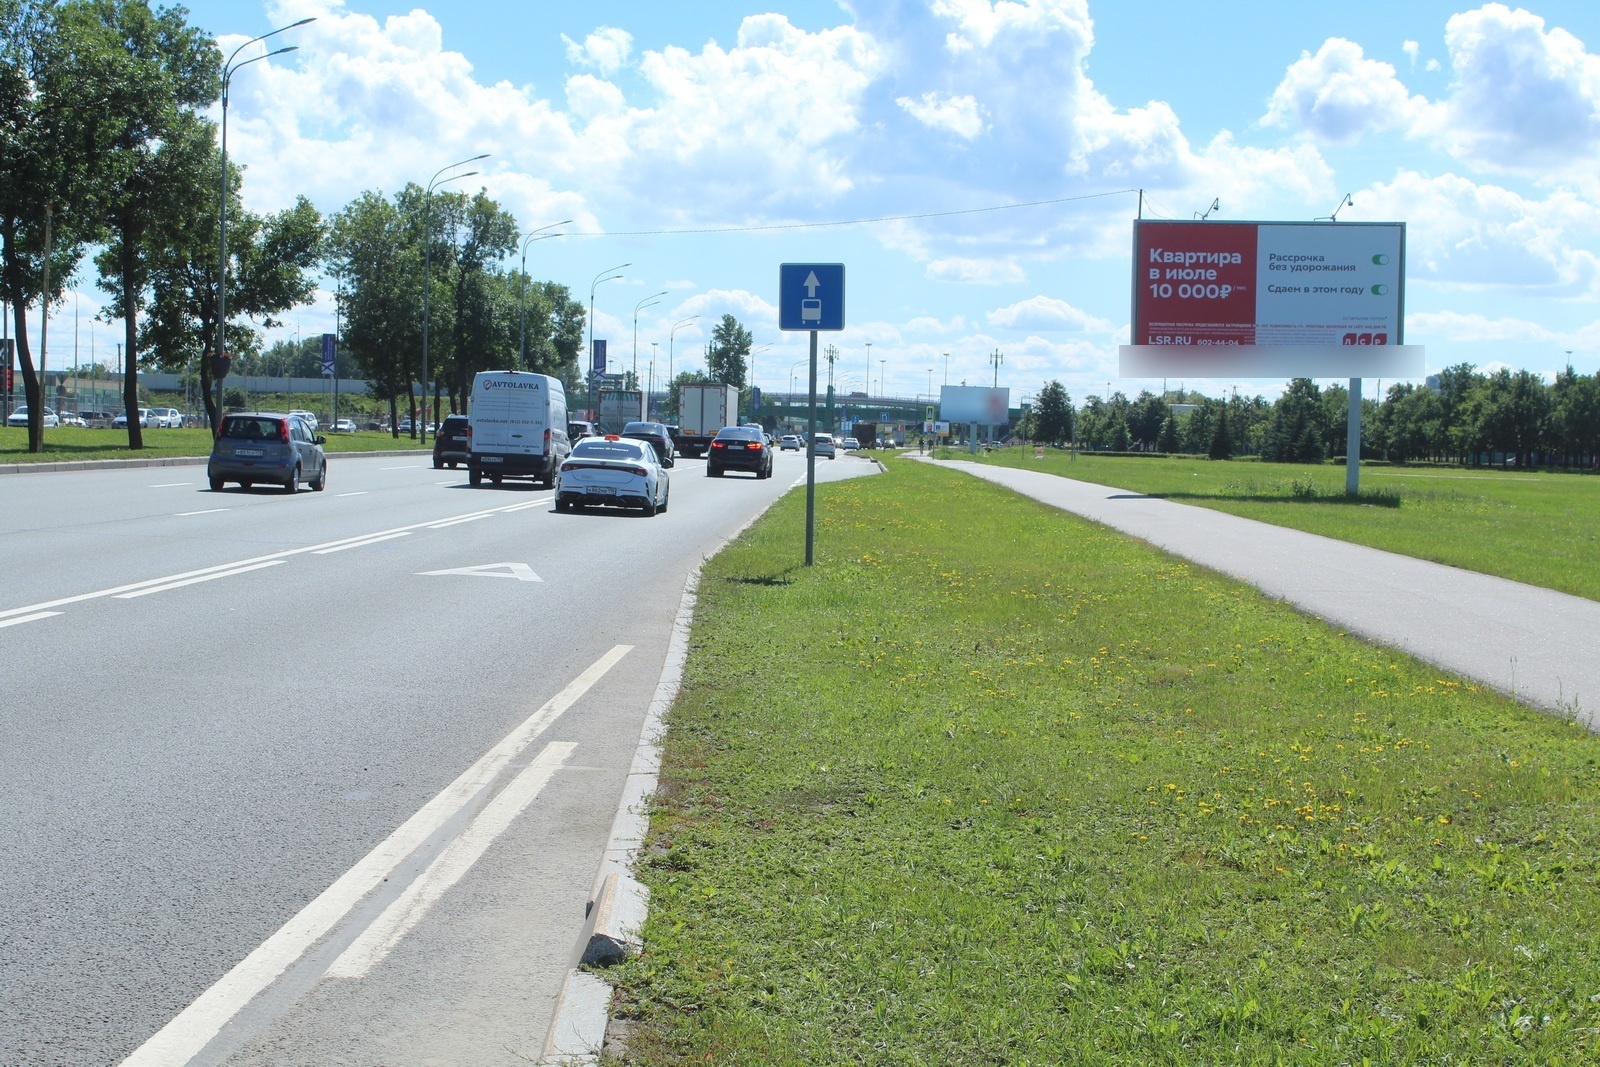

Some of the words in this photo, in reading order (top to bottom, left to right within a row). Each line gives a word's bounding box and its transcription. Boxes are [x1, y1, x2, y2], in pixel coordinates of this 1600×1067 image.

[1149, 248, 1242, 268] Квартира
[1269, 253, 1325, 263] Рассрочка
[1269, 262, 1287, 271] без
[1290, 264, 1356, 272] удорожания
[1149, 268, 1160, 280] в
[1165, 268, 1217, 280] июле
[1149, 283, 1173, 298] 10
[1267, 284, 1301, 294] Сдаем
[1340, 287, 1364, 295] году
[1148, 336, 1192, 345] LSR.RU
[1343, 337, 1383, 345] ЛСР
[492, 381, 539, 390] AVTOLAVKA
